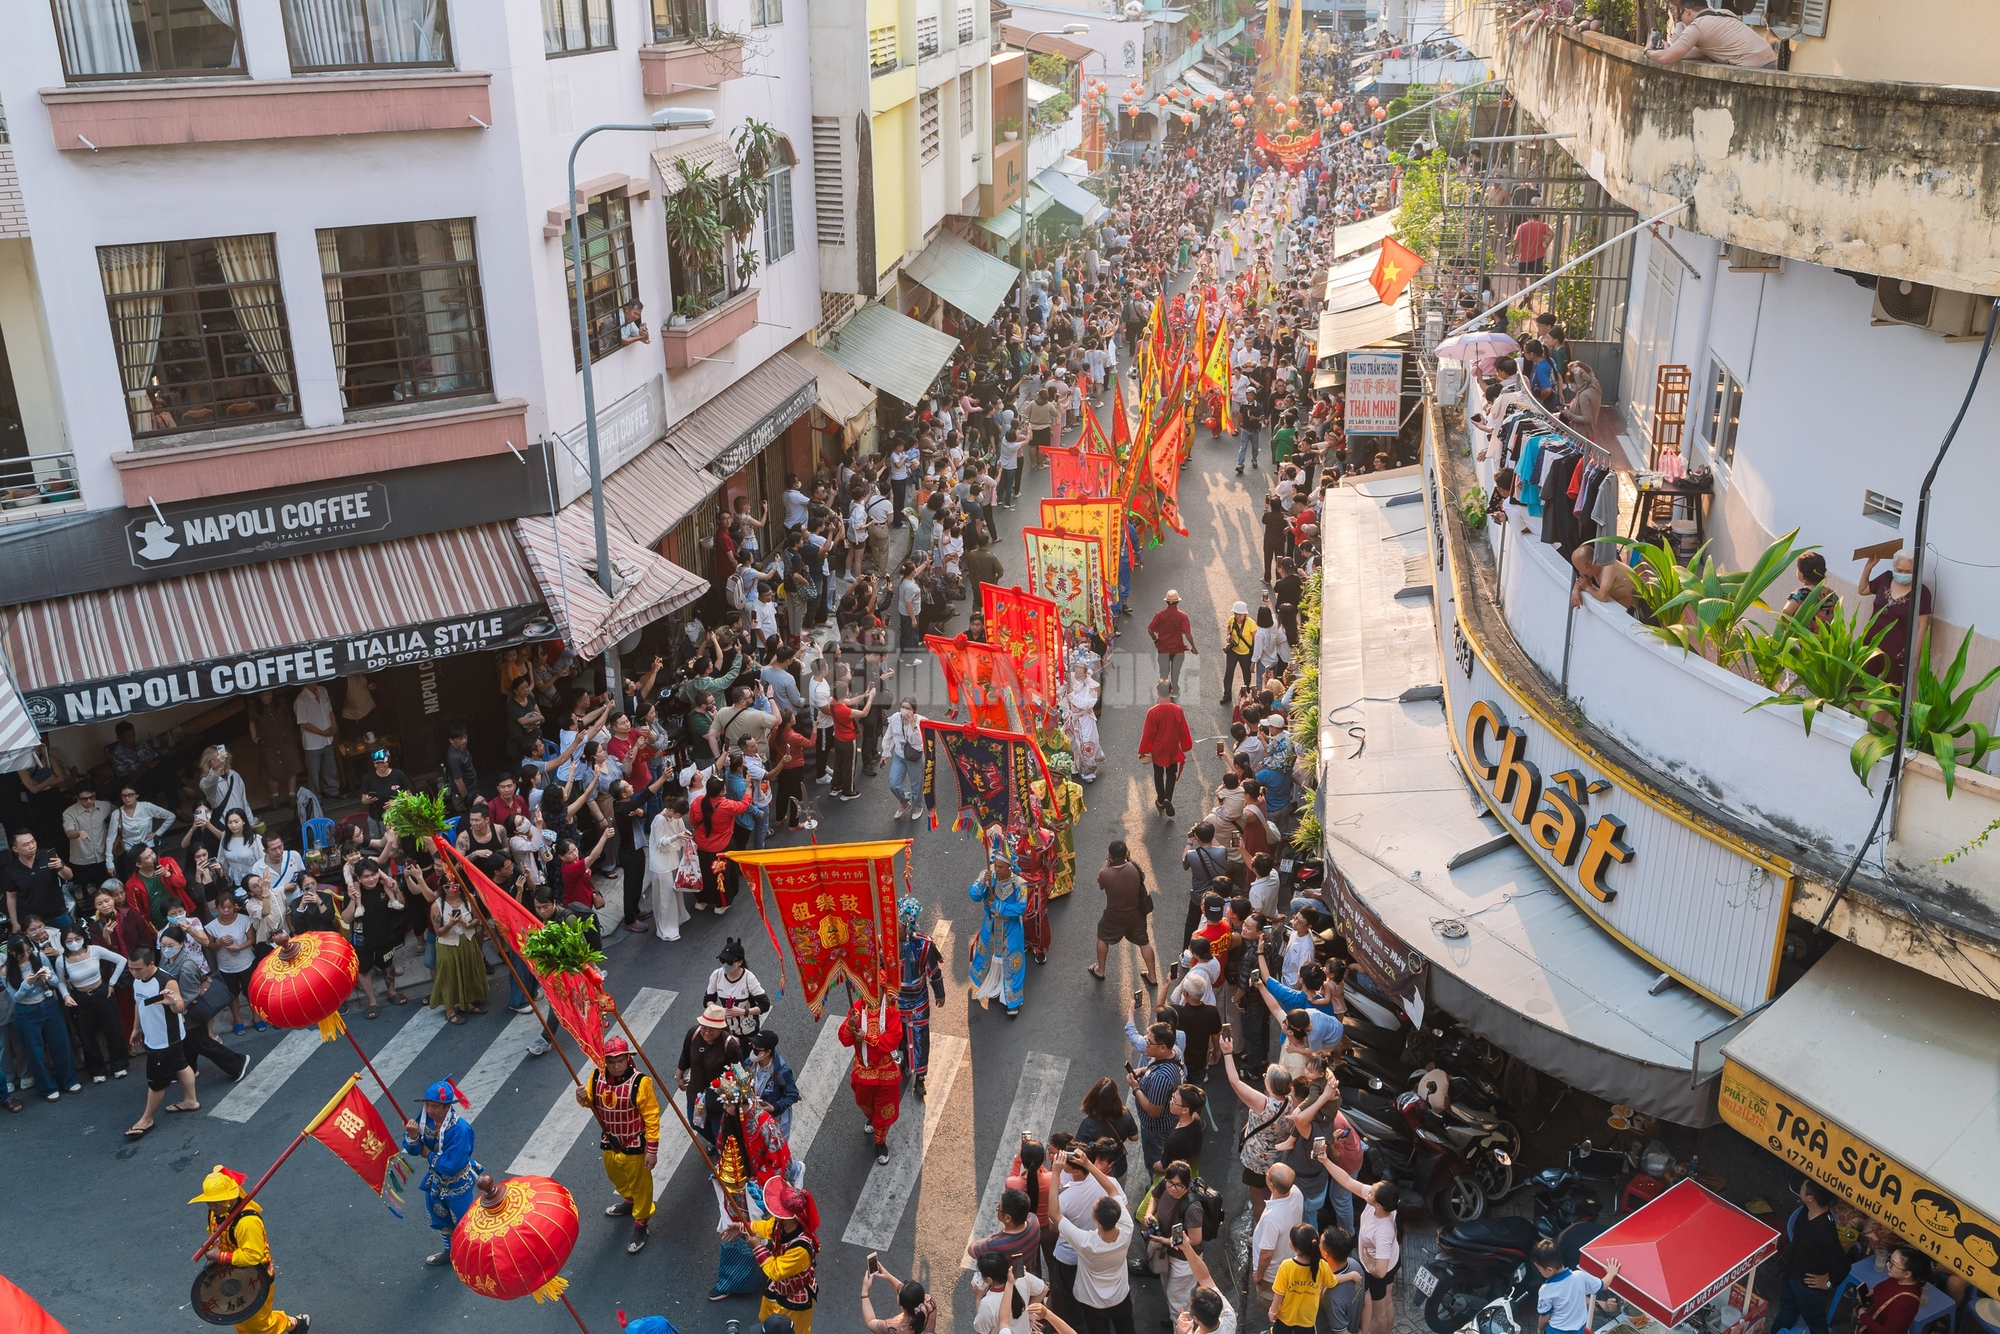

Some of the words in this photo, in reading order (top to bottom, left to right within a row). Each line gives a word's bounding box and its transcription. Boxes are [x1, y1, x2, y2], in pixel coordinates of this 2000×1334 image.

[1350, 396, 1370, 416] THÁI
[1372, 400, 1396, 417] MINH
[183, 507, 276, 546] NAPOLI
[280, 492, 371, 530] COFFEE
[277, 531, 310, 541] ITALIA
[327, 522, 357, 532] STYLE
[347, 631, 426, 661] ITALIA
[434, 617, 503, 646] STYLE
[395, 639, 487, 662] 0973.831.713
[64, 670, 199, 723] NAPOLI
[211, 646, 336, 695] COFFEE
[420, 671, 440, 715] NAPOLI
[1464, 700, 1635, 903] Chất
[1390, 949, 1406, 973] Máy
[1724, 1086, 1747, 1104] PHÁT
[1748, 1101, 1765, 1117] LỘC
[1775, 1102, 1828, 1159] TRÀ
[1837, 1147, 1902, 1205] SỮA
[1786, 1148, 1814, 1173] 177A
[1816, 1167, 1853, 1198] LƯƠNG
[1856, 1193, 1882, 1215] NHỮ
[1884, 1210, 1907, 1233] HỌC
[1919, 1235, 1941, 1256] P.11
[1952, 1258, 1975, 1277] Q.5
